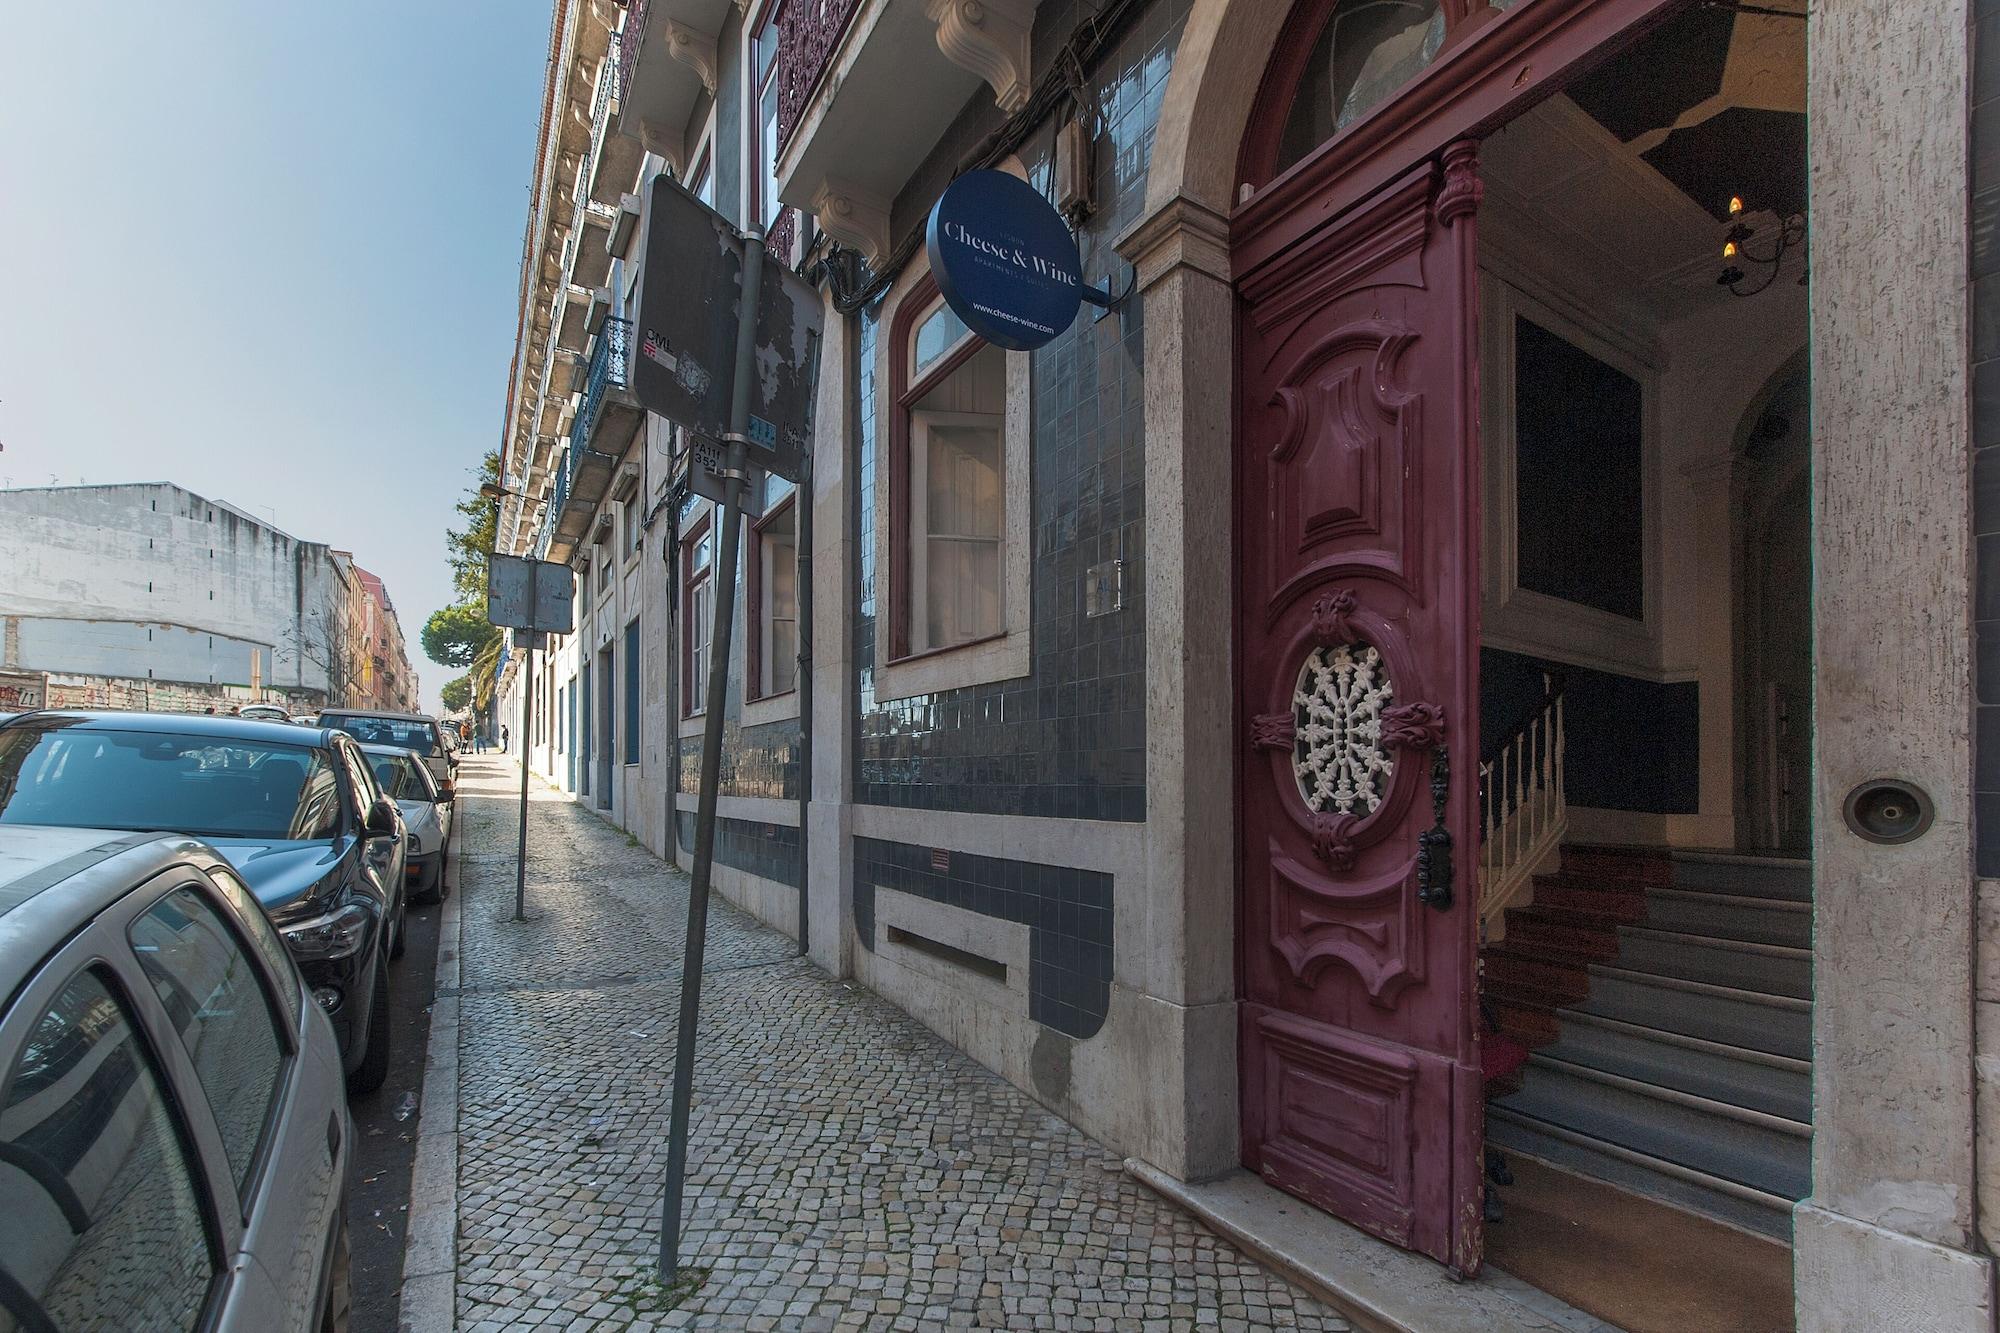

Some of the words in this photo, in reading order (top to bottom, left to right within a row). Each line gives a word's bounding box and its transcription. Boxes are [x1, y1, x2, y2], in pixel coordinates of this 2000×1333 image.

[944, 221, 1009, 260] Cheese
[1012, 249, 1028, 269] &
[1032, 255, 1077, 287] Wine
[972, 302, 1055, 335] www.cheese-wine.com
